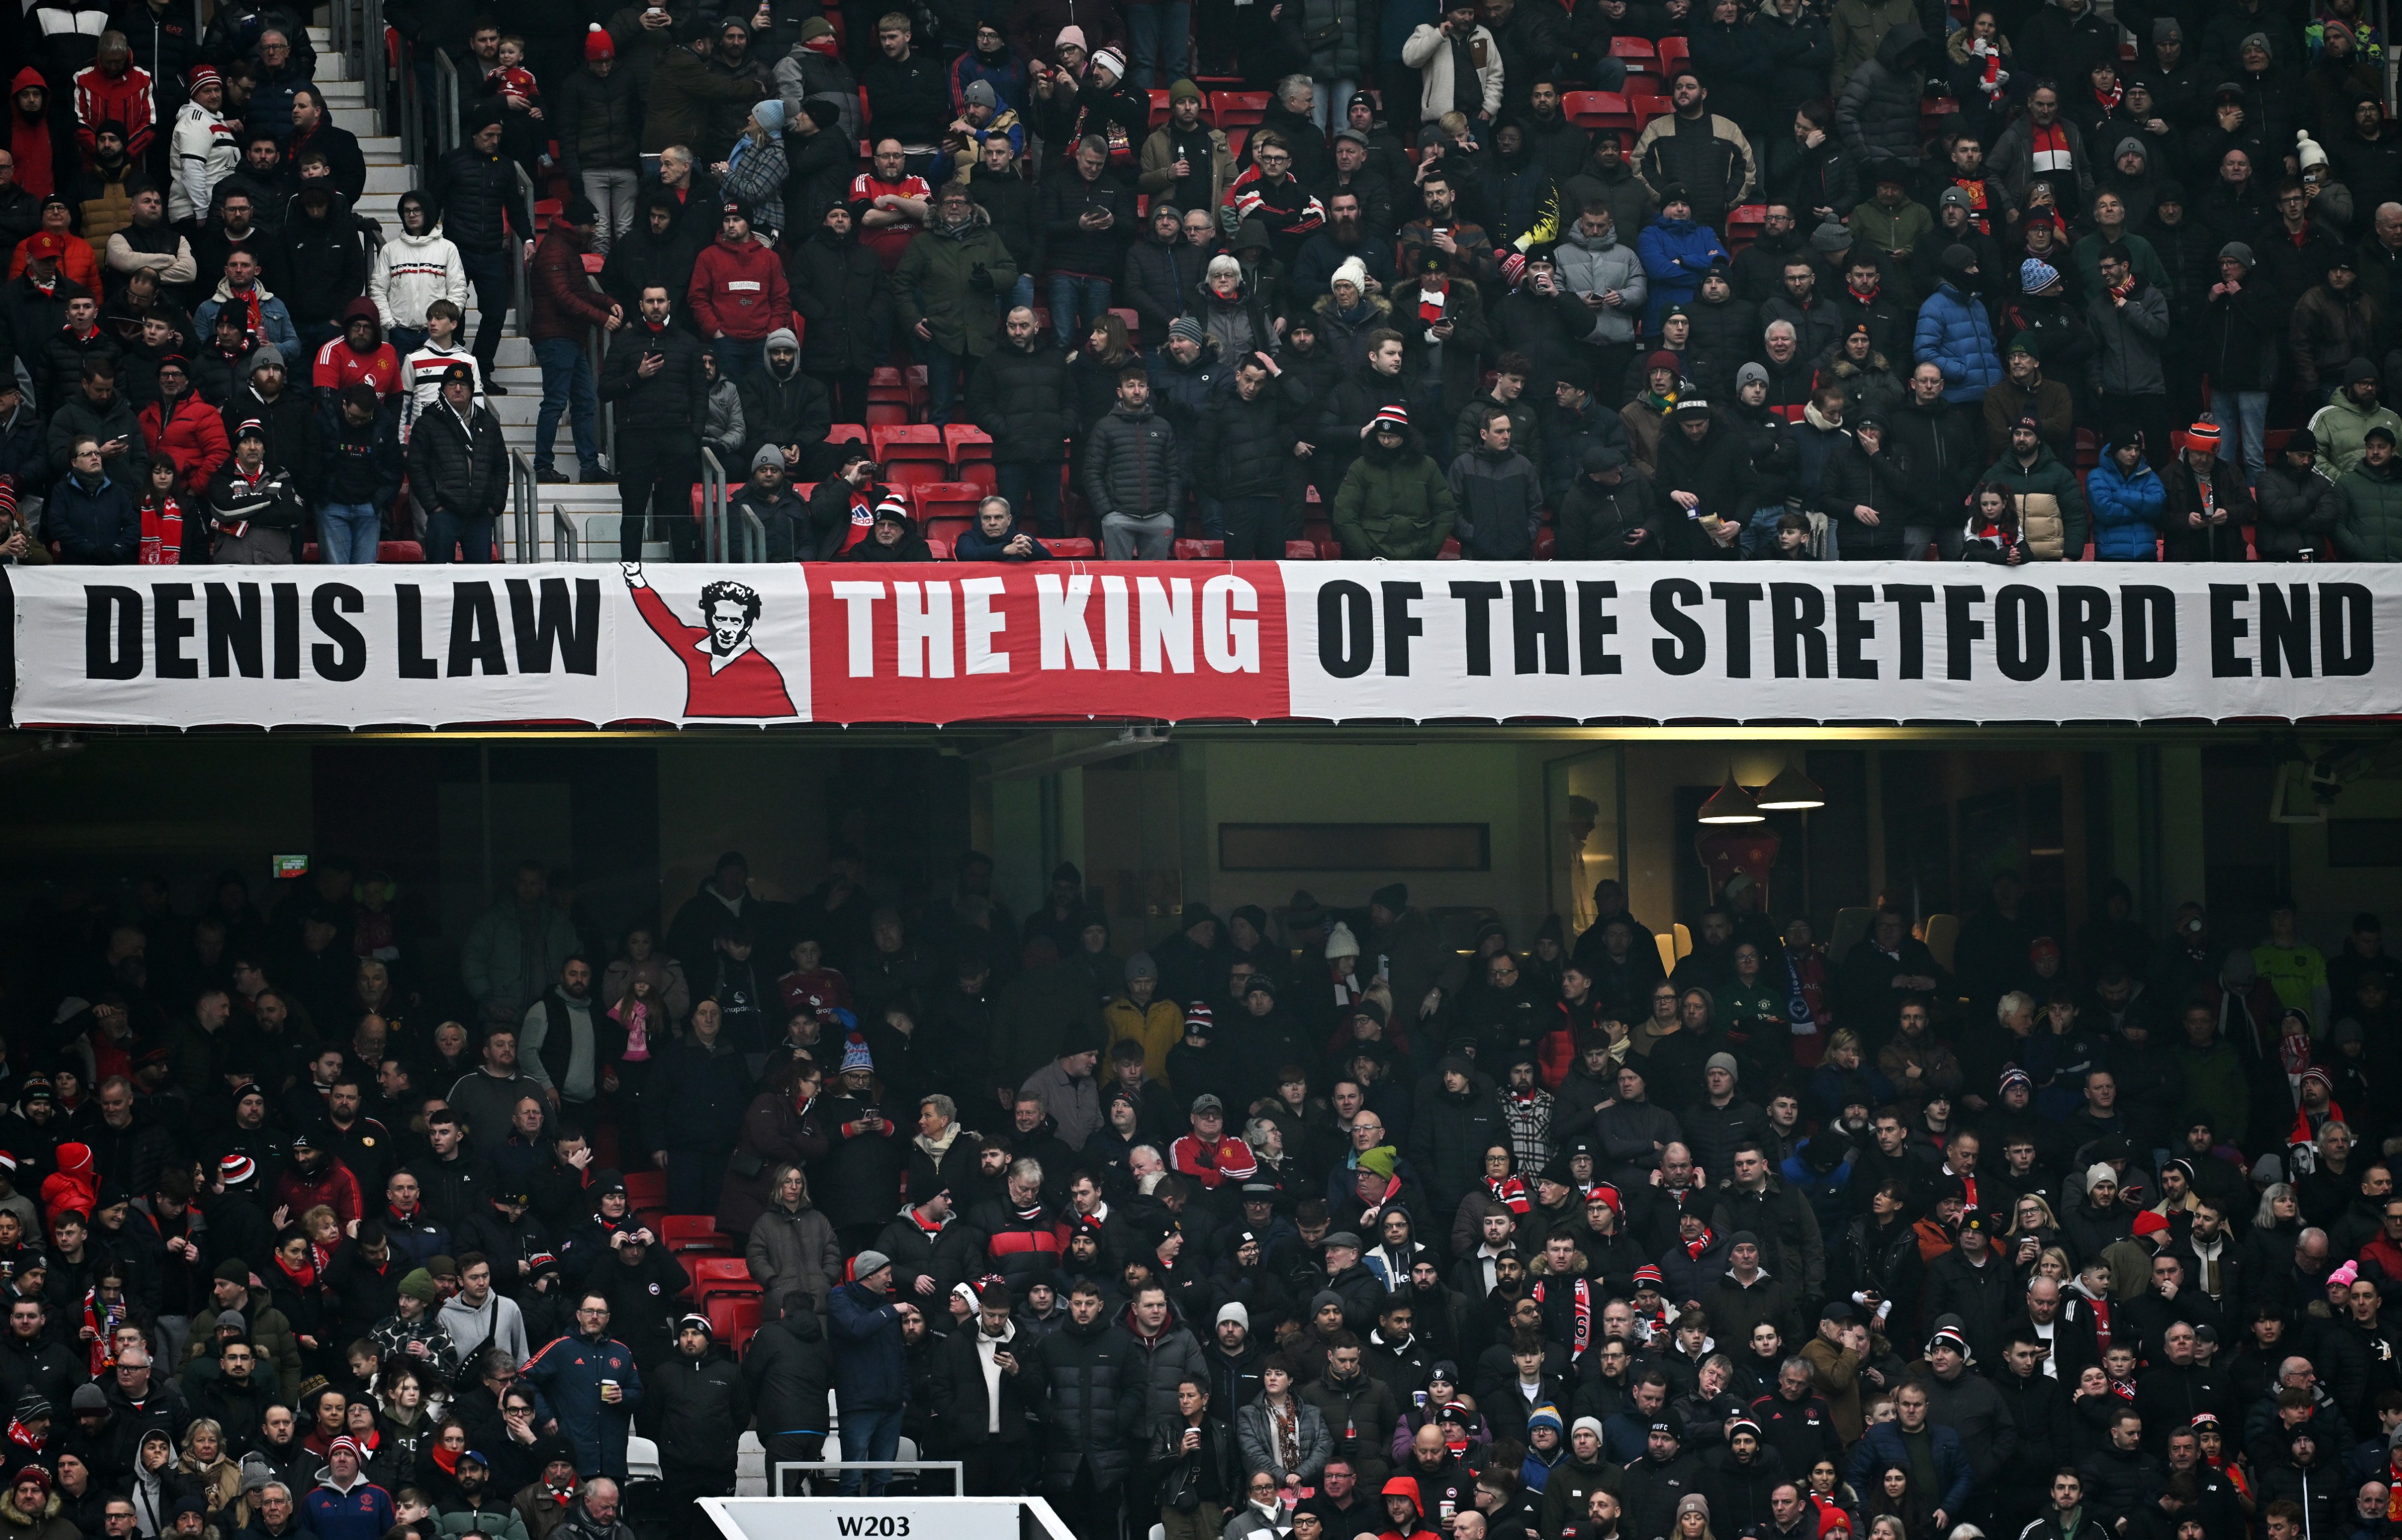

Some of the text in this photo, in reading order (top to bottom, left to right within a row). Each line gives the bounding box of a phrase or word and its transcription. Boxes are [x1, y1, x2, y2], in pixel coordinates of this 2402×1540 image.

[166, 24, 183, 36] EA7
[84, 574, 2374, 681] DENIS LAW THE KING OF THE STRETFORD END
[837, 1517, 910, 1536] W203
